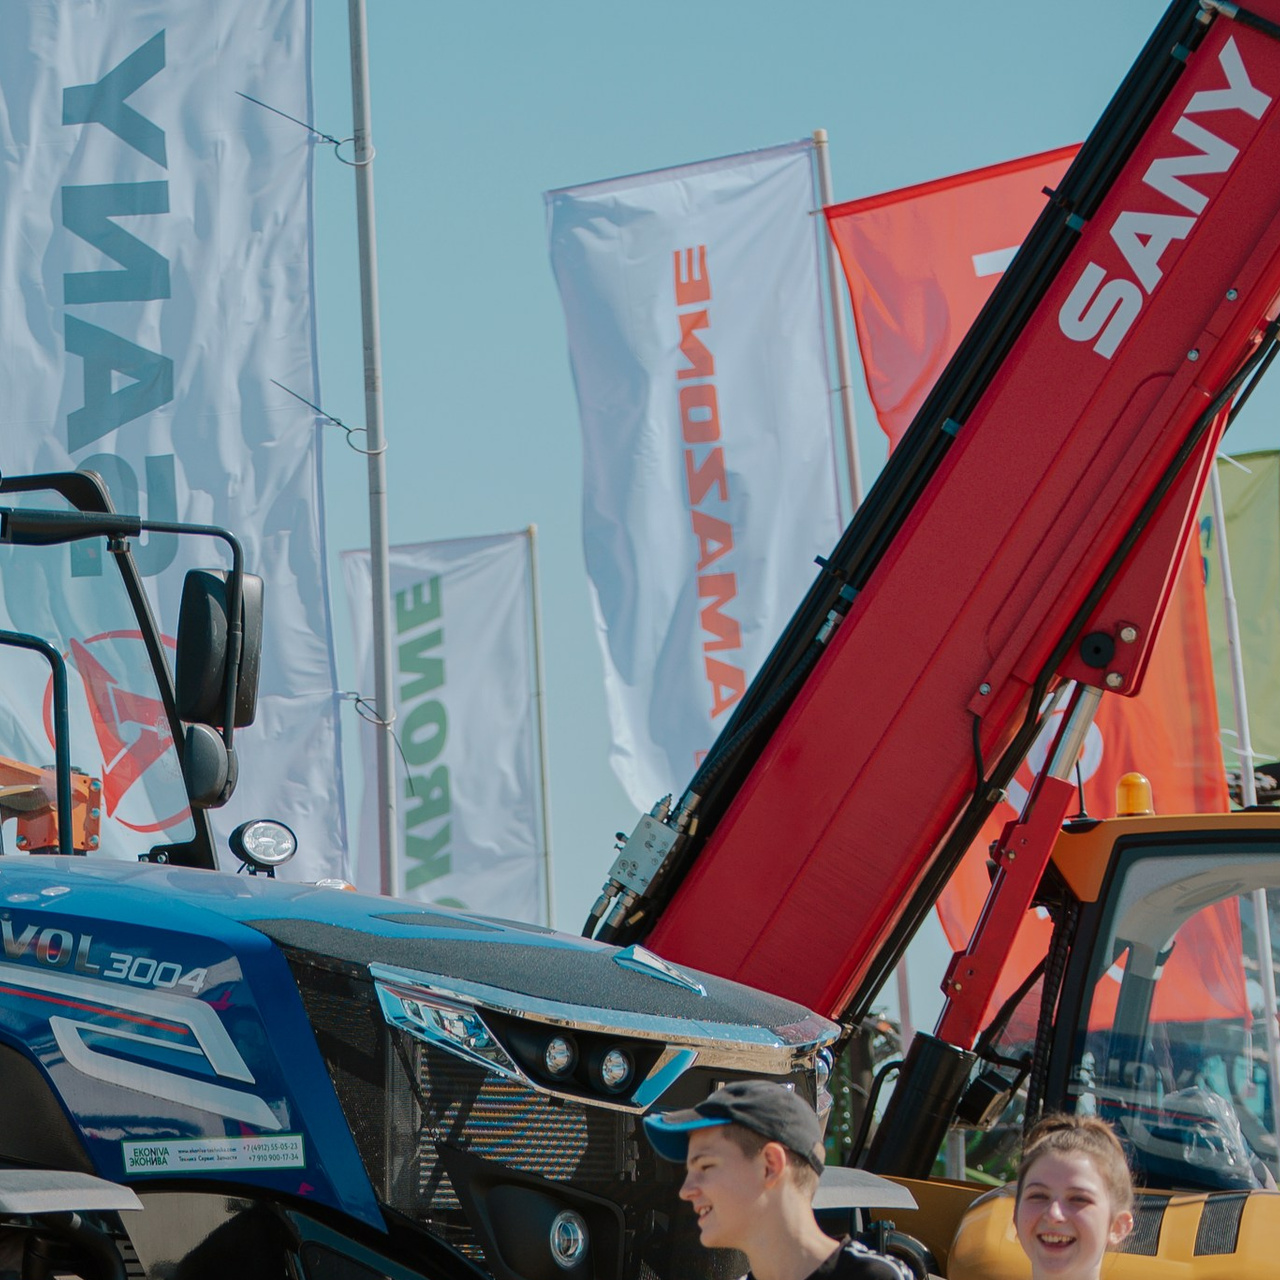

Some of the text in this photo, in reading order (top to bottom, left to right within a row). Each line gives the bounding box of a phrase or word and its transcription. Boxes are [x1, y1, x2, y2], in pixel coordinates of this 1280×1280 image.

[1058, 36, 1272, 360] SANY
[104, 952, 208, 993] 3004
[133, 1147, 170, 1157] EKONIVA
[270, 1143, 299, 1152] 55-05-23
[129, 1156, 168, 1167] ЭКОНИВА
[256, 1154, 268, 1163] 910
[269, 1153, 299, 1162] 900-17-34
